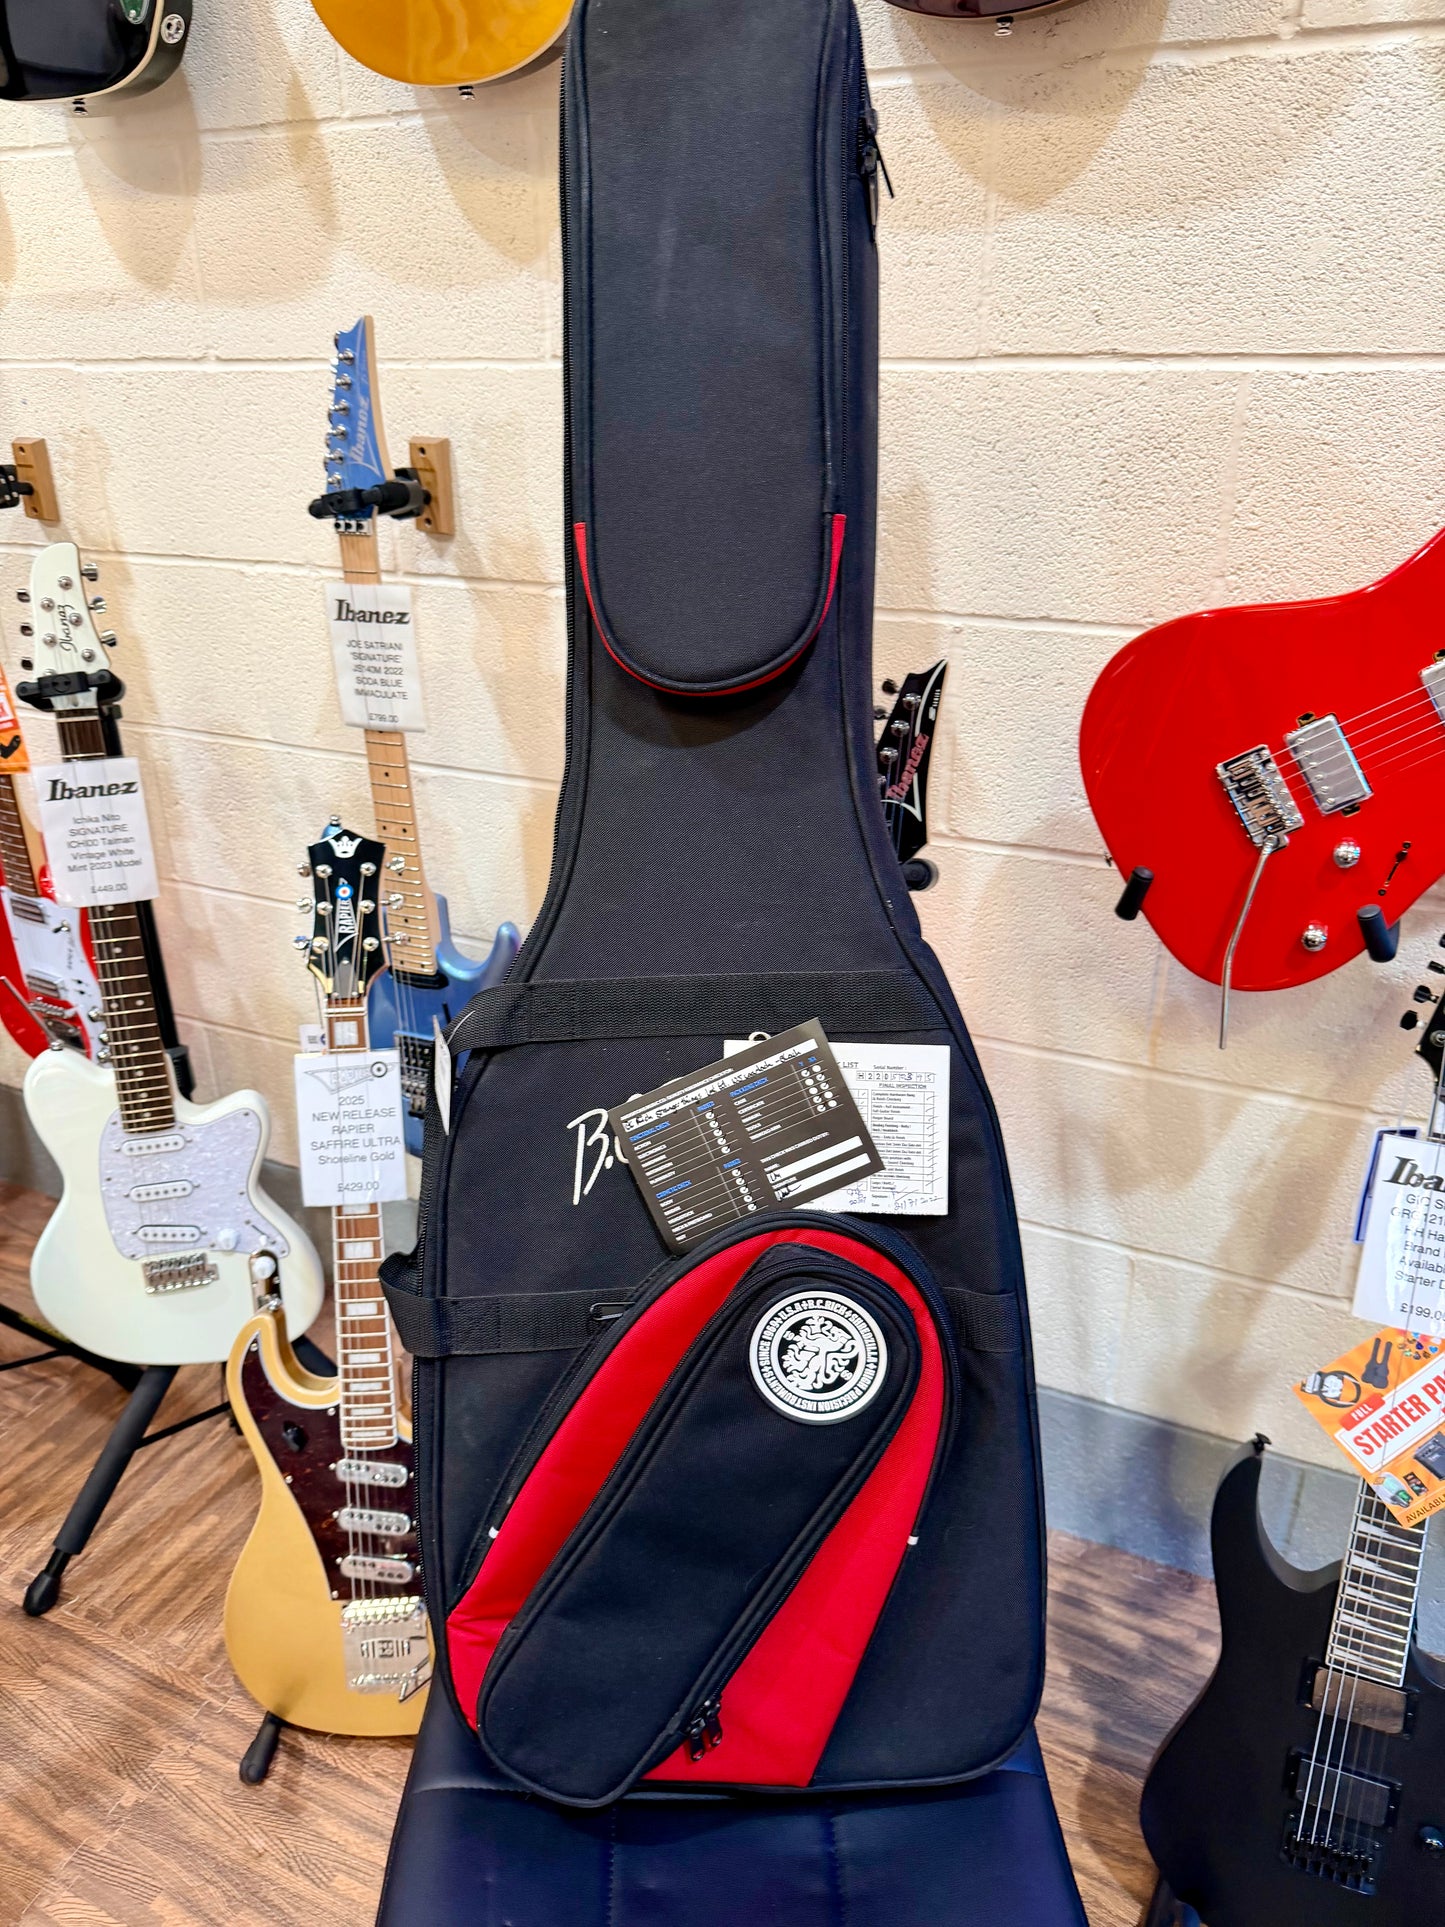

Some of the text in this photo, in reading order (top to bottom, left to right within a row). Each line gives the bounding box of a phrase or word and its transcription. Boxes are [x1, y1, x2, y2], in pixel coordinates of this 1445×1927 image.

[334, 599, 410, 625] Ibanez
[346, 640, 403, 651] JOE SATRIANI
[383, 666, 404, 676] 2022
[380, 678, 403, 688] BLUE
[353, 688, 408, 700] IMMACULATE
[45, 779, 139, 802] Ibanez
[101, 813, 121, 822] Nito
[69, 823, 129, 837] SIGNATURE
[71, 848, 135, 861] Vintage White
[67, 858, 142, 873] Mint 2023 Model
[338, 1096, 365, 1106] 2025
[312, 1107, 397, 1122] NEW RELEASE
[331, 1123, 375, 1134] RAPIER
[310, 1136, 401, 1151] SAFFIRE ULTRA
[318, 1150, 396, 1166] Shoreline Gold
[1382, 1155, 1445, 1192] Iba
[337, 1181, 380, 1193] £429.00
[1403, 1240, 1440, 1257] Brand
[1394, 1270, 1436, 1287] Starter
[758, 1318, 779, 1367] SINCE 1969
[849, 1313, 879, 1364] SHREDZILLA
[762, 1368, 877, 1412] HIGH PRECISION INSTRUMENTS
[1350, 1402, 1374, 1422] FULL
[1353, 1393, 1432, 1456] STARTER
